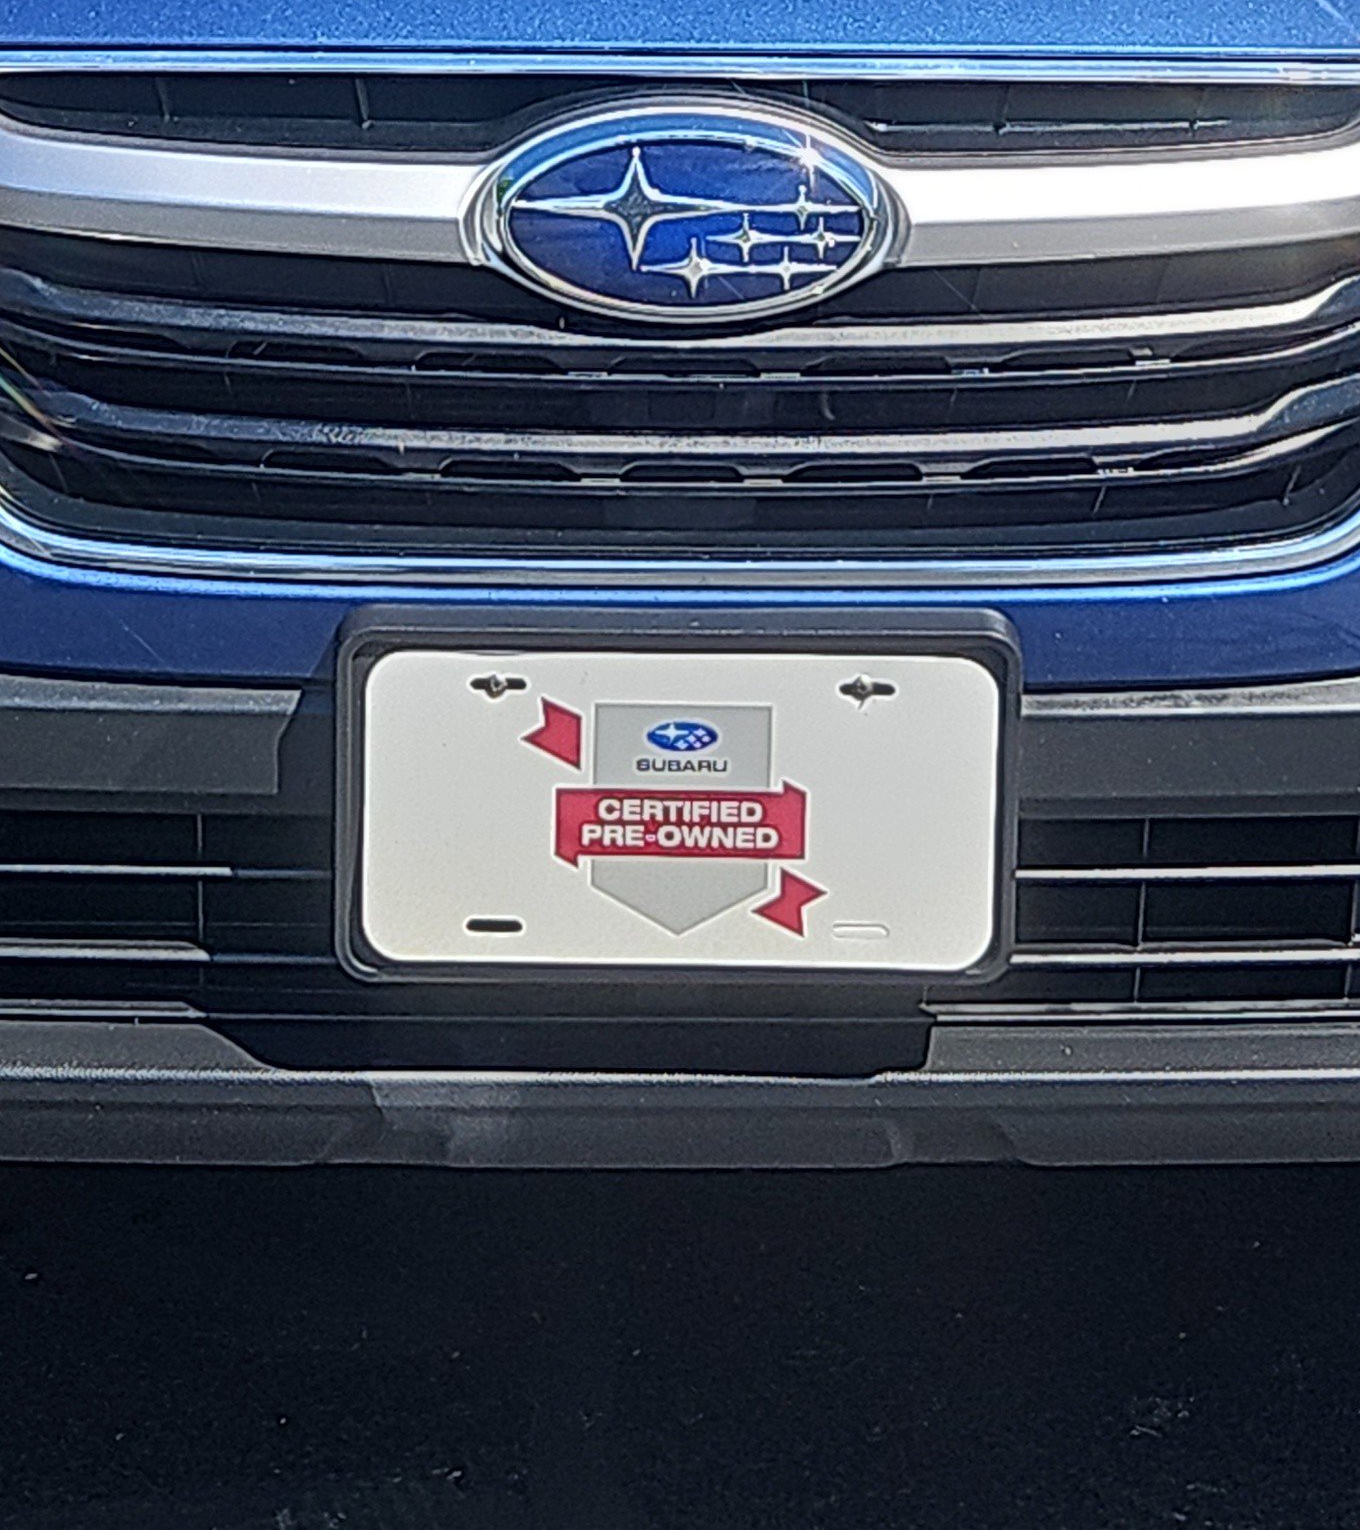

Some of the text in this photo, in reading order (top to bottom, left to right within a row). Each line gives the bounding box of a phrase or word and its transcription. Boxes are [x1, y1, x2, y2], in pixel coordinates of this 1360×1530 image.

[636, 759, 728, 773] SUBARU
[597, 798, 764, 823] CERTIFIED
[580, 823, 780, 849] PRE-OWNED
